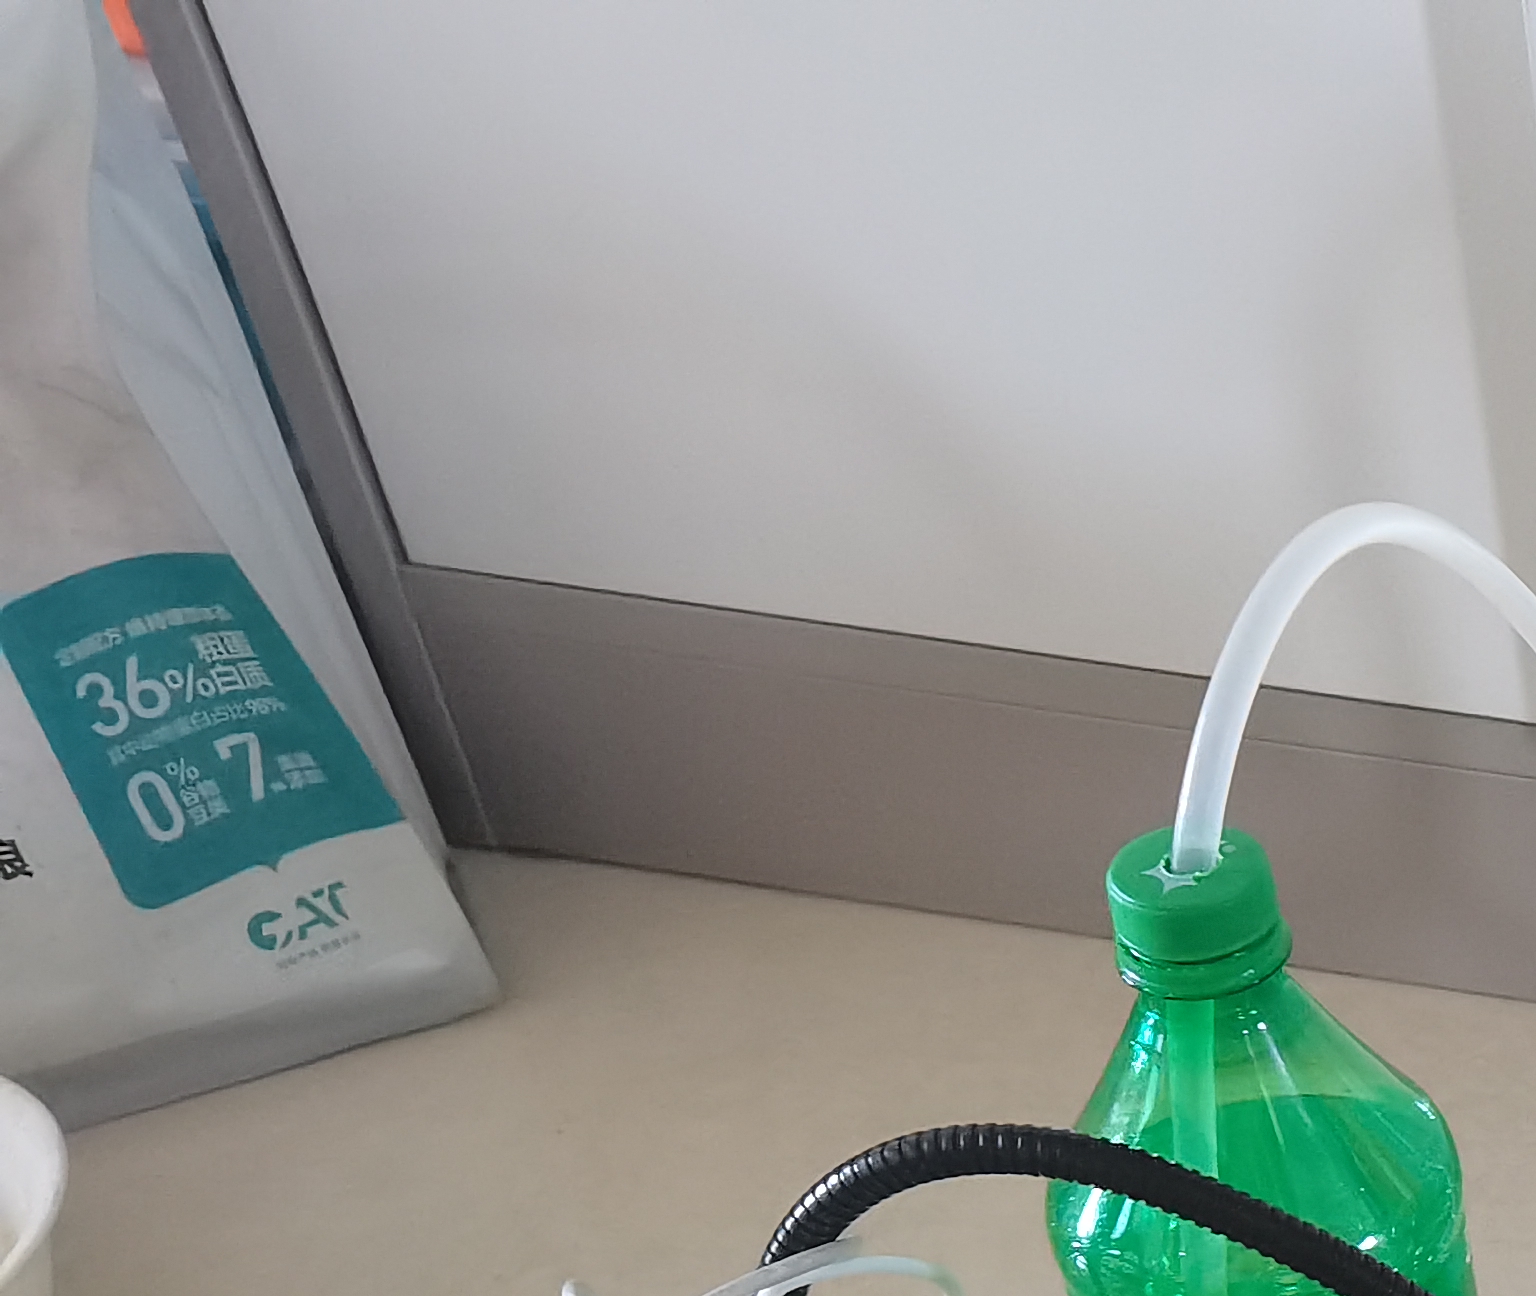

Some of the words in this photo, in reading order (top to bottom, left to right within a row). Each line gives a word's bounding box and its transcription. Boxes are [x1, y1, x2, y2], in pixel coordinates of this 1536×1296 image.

[75, 655, 215, 736] 36%
[213, 732, 265, 801] 7
[247, 881, 351, 952] CAT
